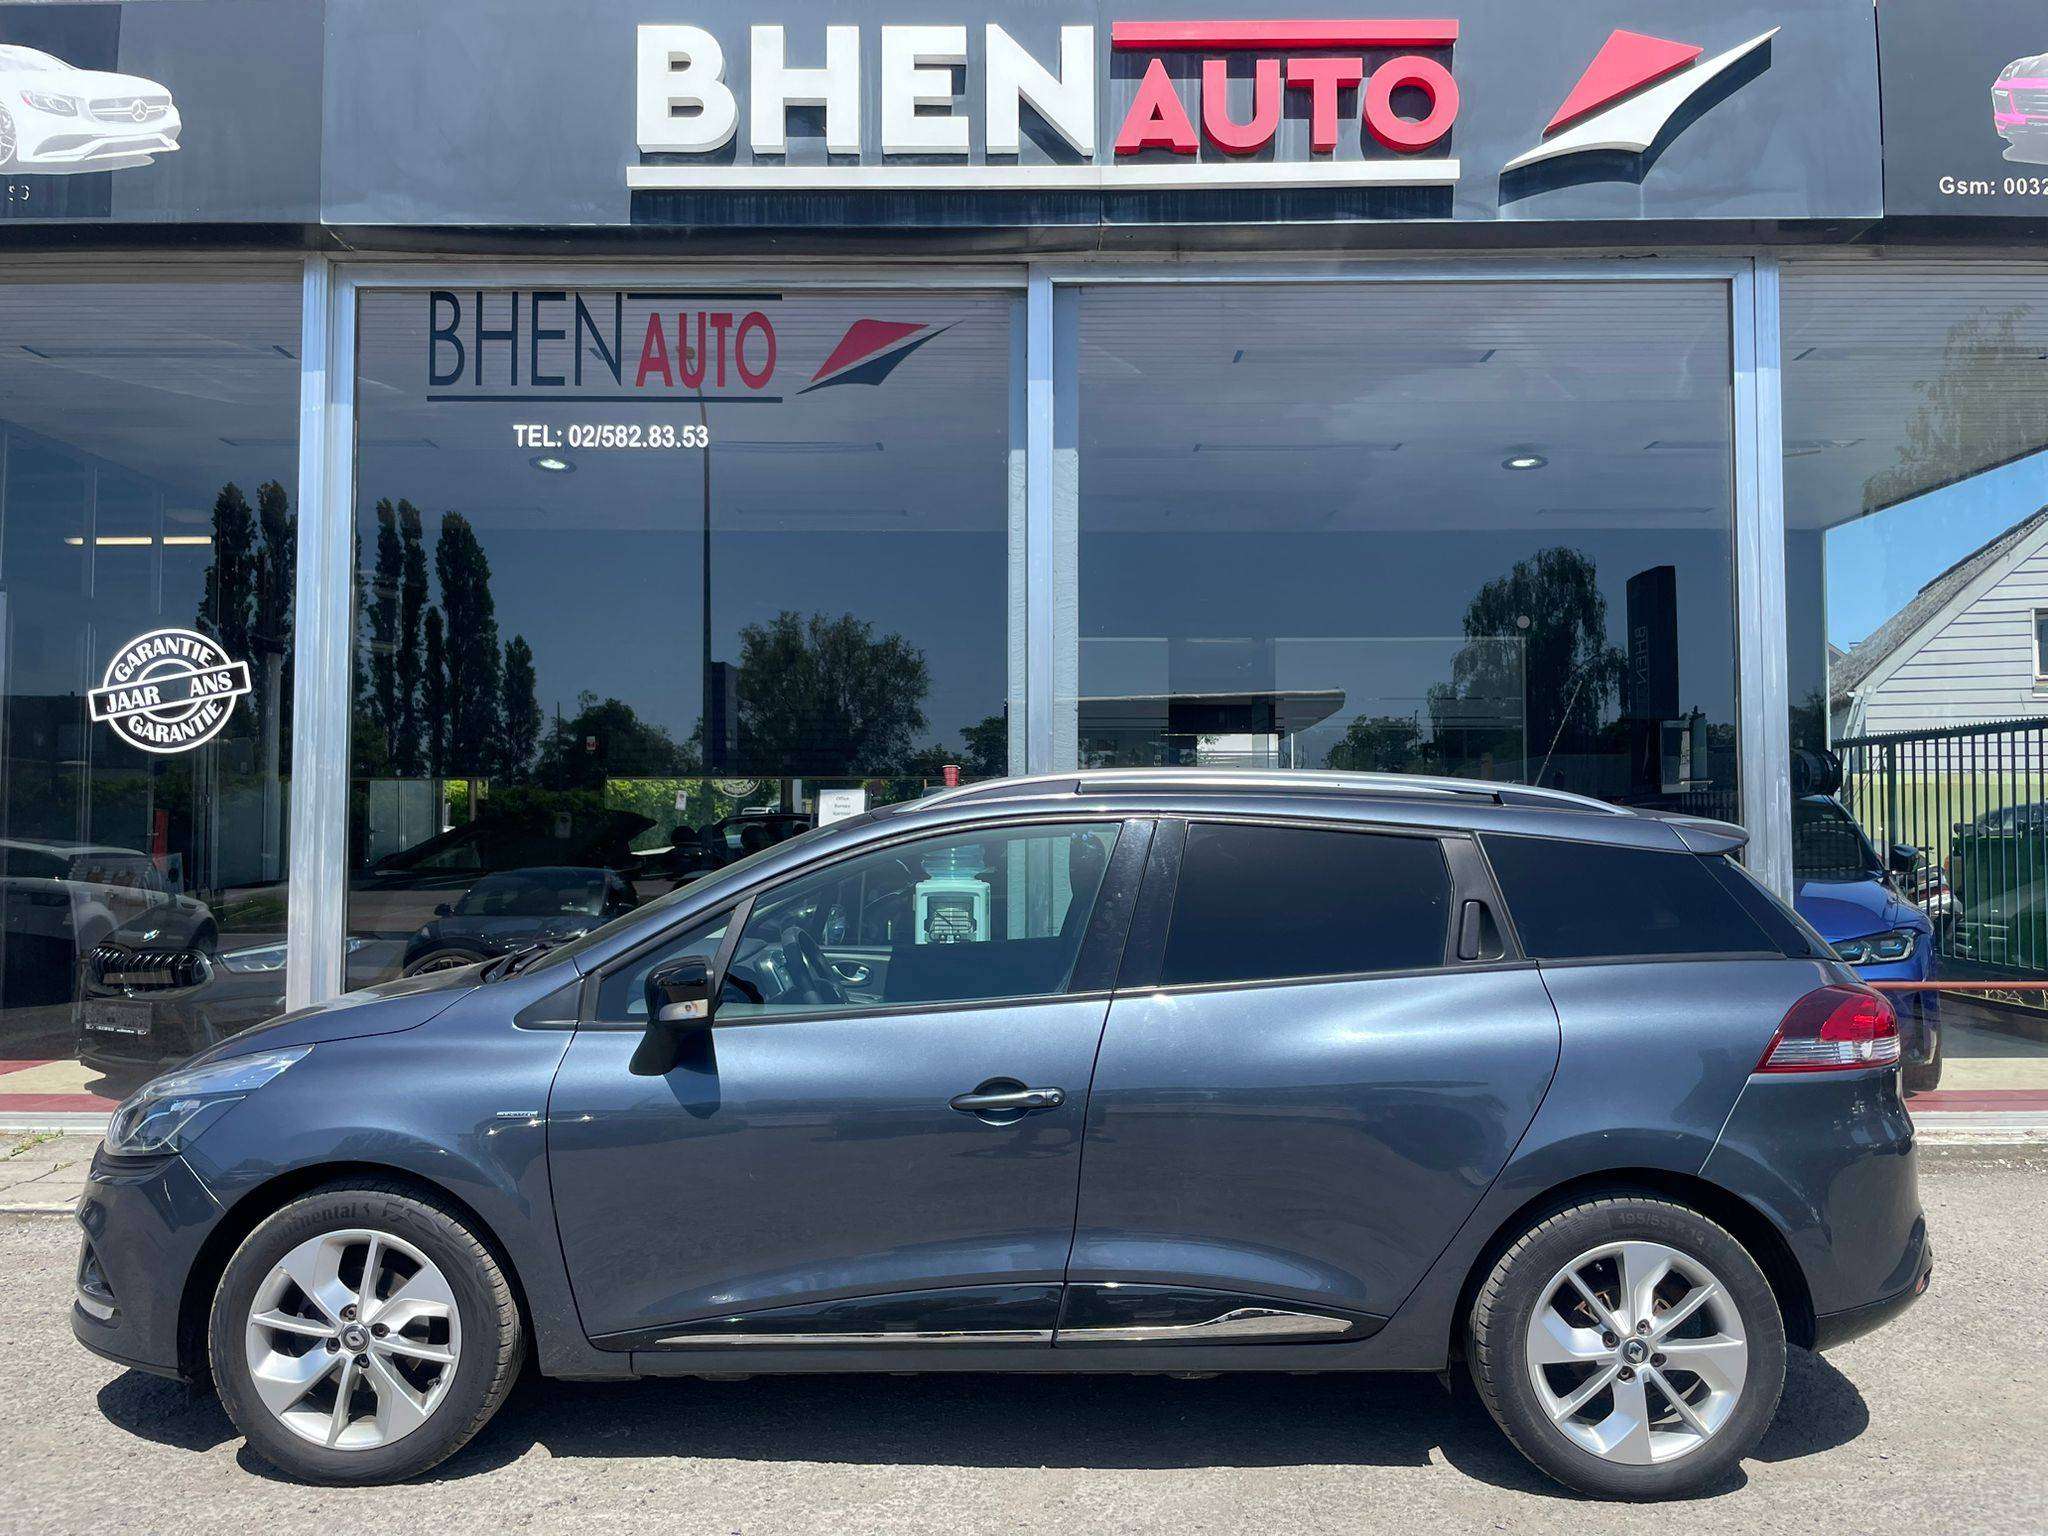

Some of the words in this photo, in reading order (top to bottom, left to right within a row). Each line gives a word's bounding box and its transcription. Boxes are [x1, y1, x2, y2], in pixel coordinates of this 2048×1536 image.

[636, 22, 1095, 157] BHEN
[1113, 55, 1460, 156] AUTO
[1938, 175, 1996, 195] Gsm:
[429, 290, 623, 387] BHEN
[635, 310, 777, 390] AUTO
[512, 424, 562, 448] TEL:
[568, 424, 709, 448] 02/582.83.53
[114, 637, 216, 682] GARANTIE
[106, 686, 162, 714] JAAR
[190, 671, 233, 698] ANS
[128, 701, 224, 743] GARANTIE
